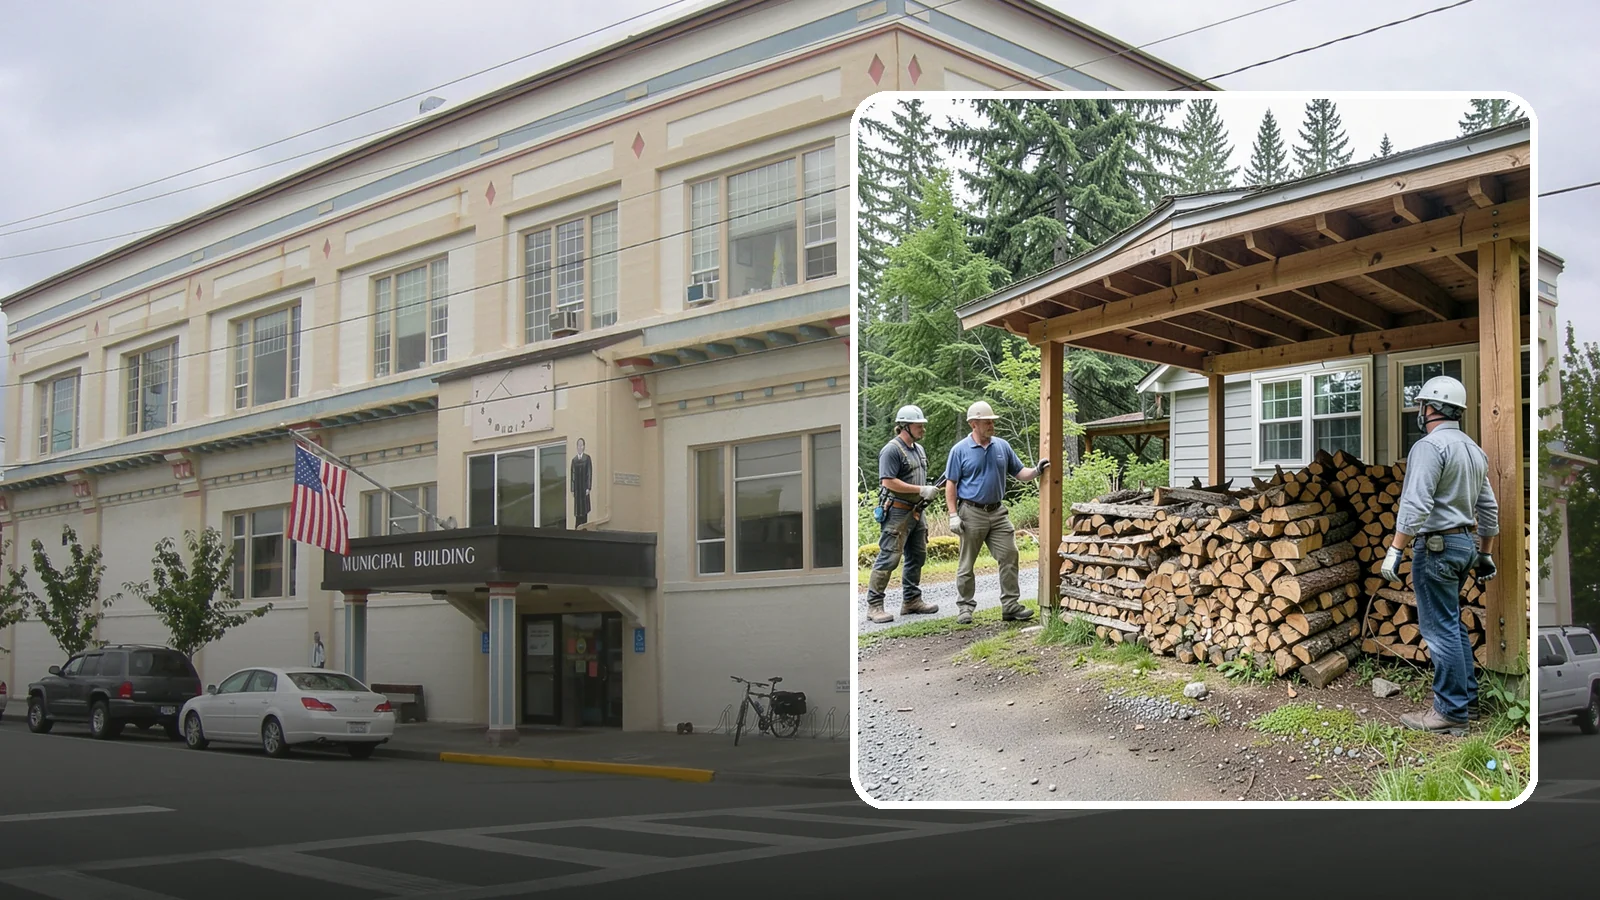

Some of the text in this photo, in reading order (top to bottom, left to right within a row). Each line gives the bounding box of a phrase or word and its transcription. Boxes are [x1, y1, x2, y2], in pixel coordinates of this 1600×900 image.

[480, 407, 485, 415] 8
[487, 417, 492, 426] 9
[494, 423, 500, 432] 10
[507, 425, 513, 434] 12
[521, 420, 526, 428] 2
[528, 413, 533, 422] 3
[536, 402, 540, 410] 4
[342, 546, 475, 572] MUNICIPAL BUILDING
